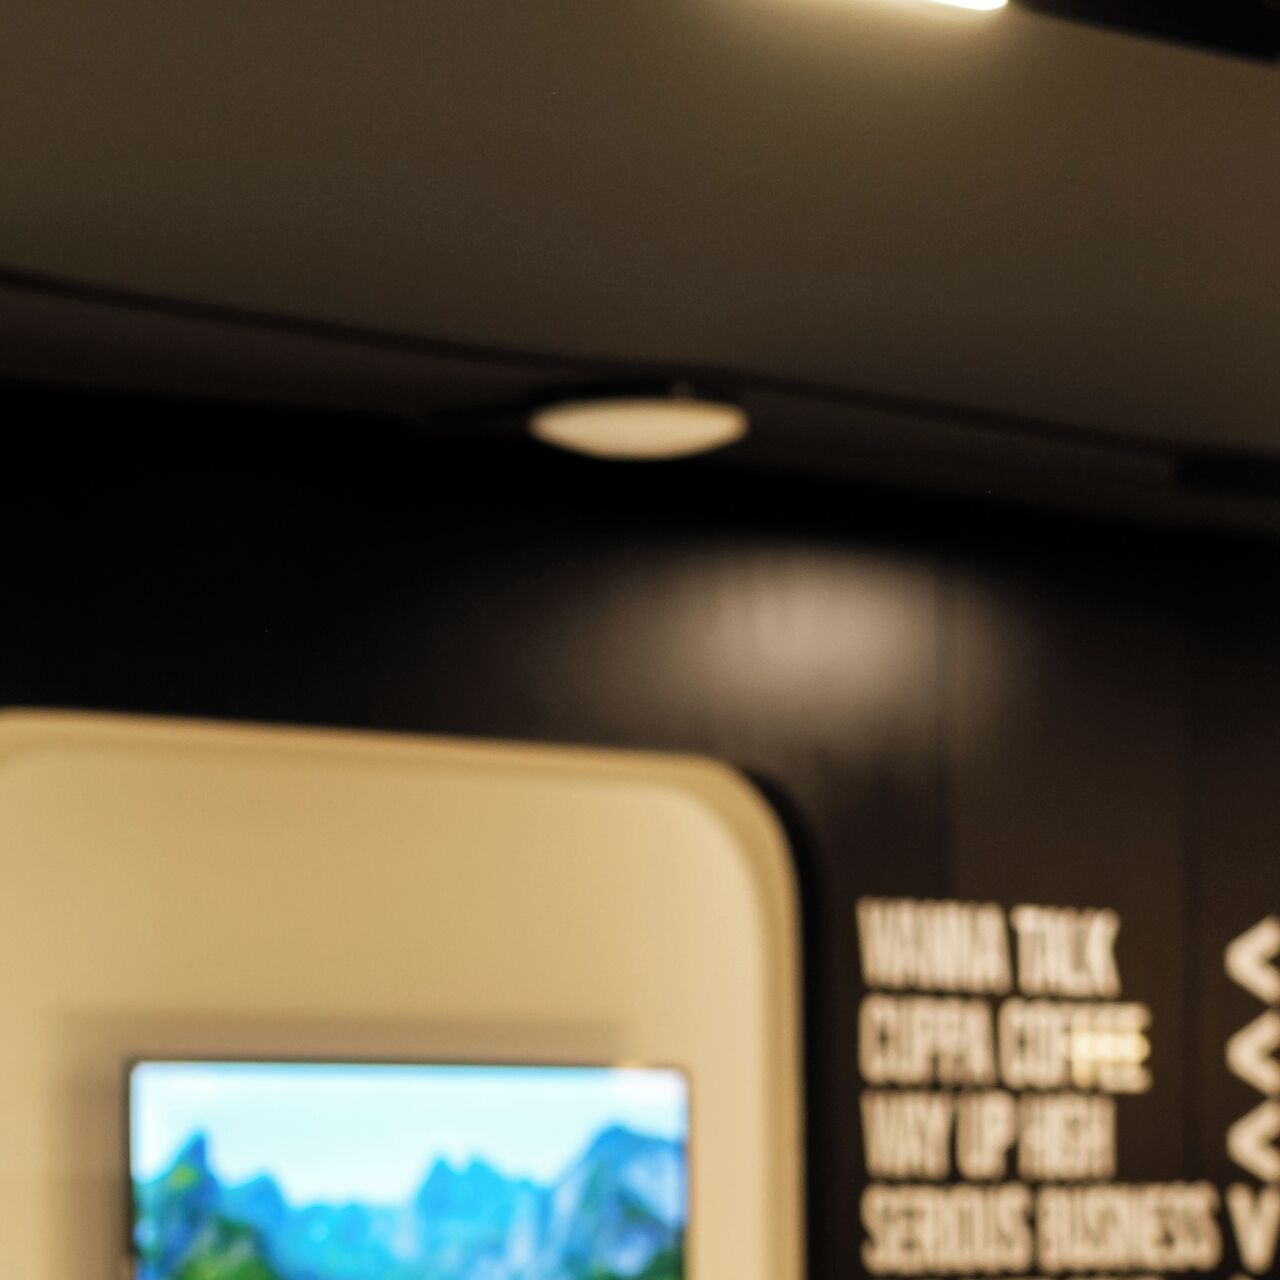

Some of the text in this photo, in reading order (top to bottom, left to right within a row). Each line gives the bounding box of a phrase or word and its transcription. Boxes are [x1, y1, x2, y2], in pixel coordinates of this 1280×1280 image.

[859, 898, 1121, 996] WANNA TALK
[859, 995, 1151, 1093] CUPPA COFFEE
[861, 1091, 1117, 1180] WAY UP HIGH
[862, 1181, 1222, 1275] SERIOUS BUSINESS
